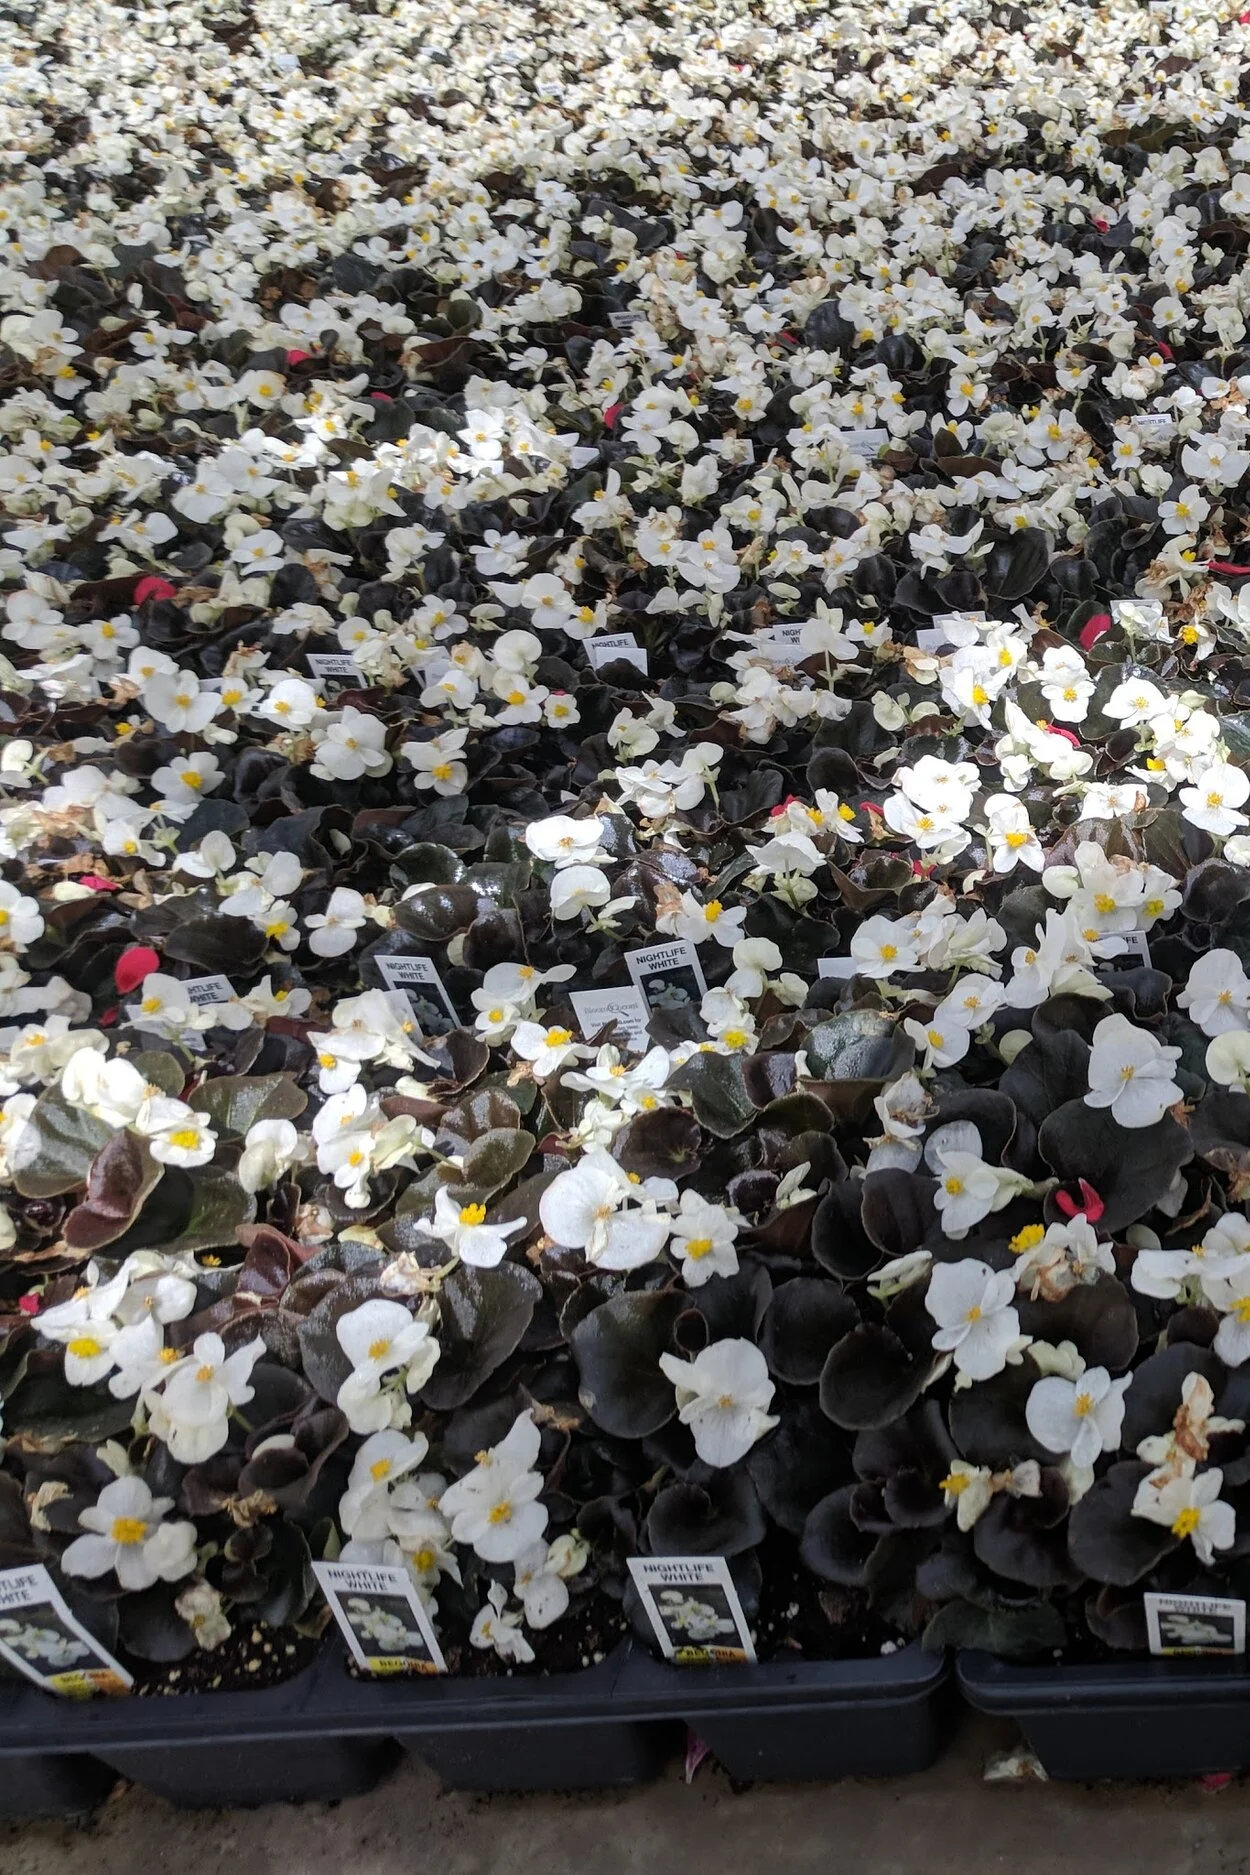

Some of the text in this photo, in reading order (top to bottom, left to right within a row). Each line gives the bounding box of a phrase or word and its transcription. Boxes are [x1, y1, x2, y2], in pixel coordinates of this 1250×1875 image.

[591, 638, 630, 649] NIGHTLIFE
[315, 658, 353, 667] NIGHTLIFE
[324, 666, 350, 674] WHITE
[636, 946, 687, 965] NIGHTLIFE
[385, 961, 429, 972] NIGHTLIFE
[648, 957, 680, 971] WHITE
[397, 971, 425, 981] WHITE
[187, 982, 224, 995] HTLIFE
[643, 1563, 716, 1574] NIGHTLIFE
[327, 1568, 397, 1582] NIGHTLIFE
[660, 1572, 704, 1582] WHITE
[0, 1573, 38, 1593] TLIFE
[345, 1578, 388, 1592] WHITE
[0, 1588, 31, 1605] HITE
